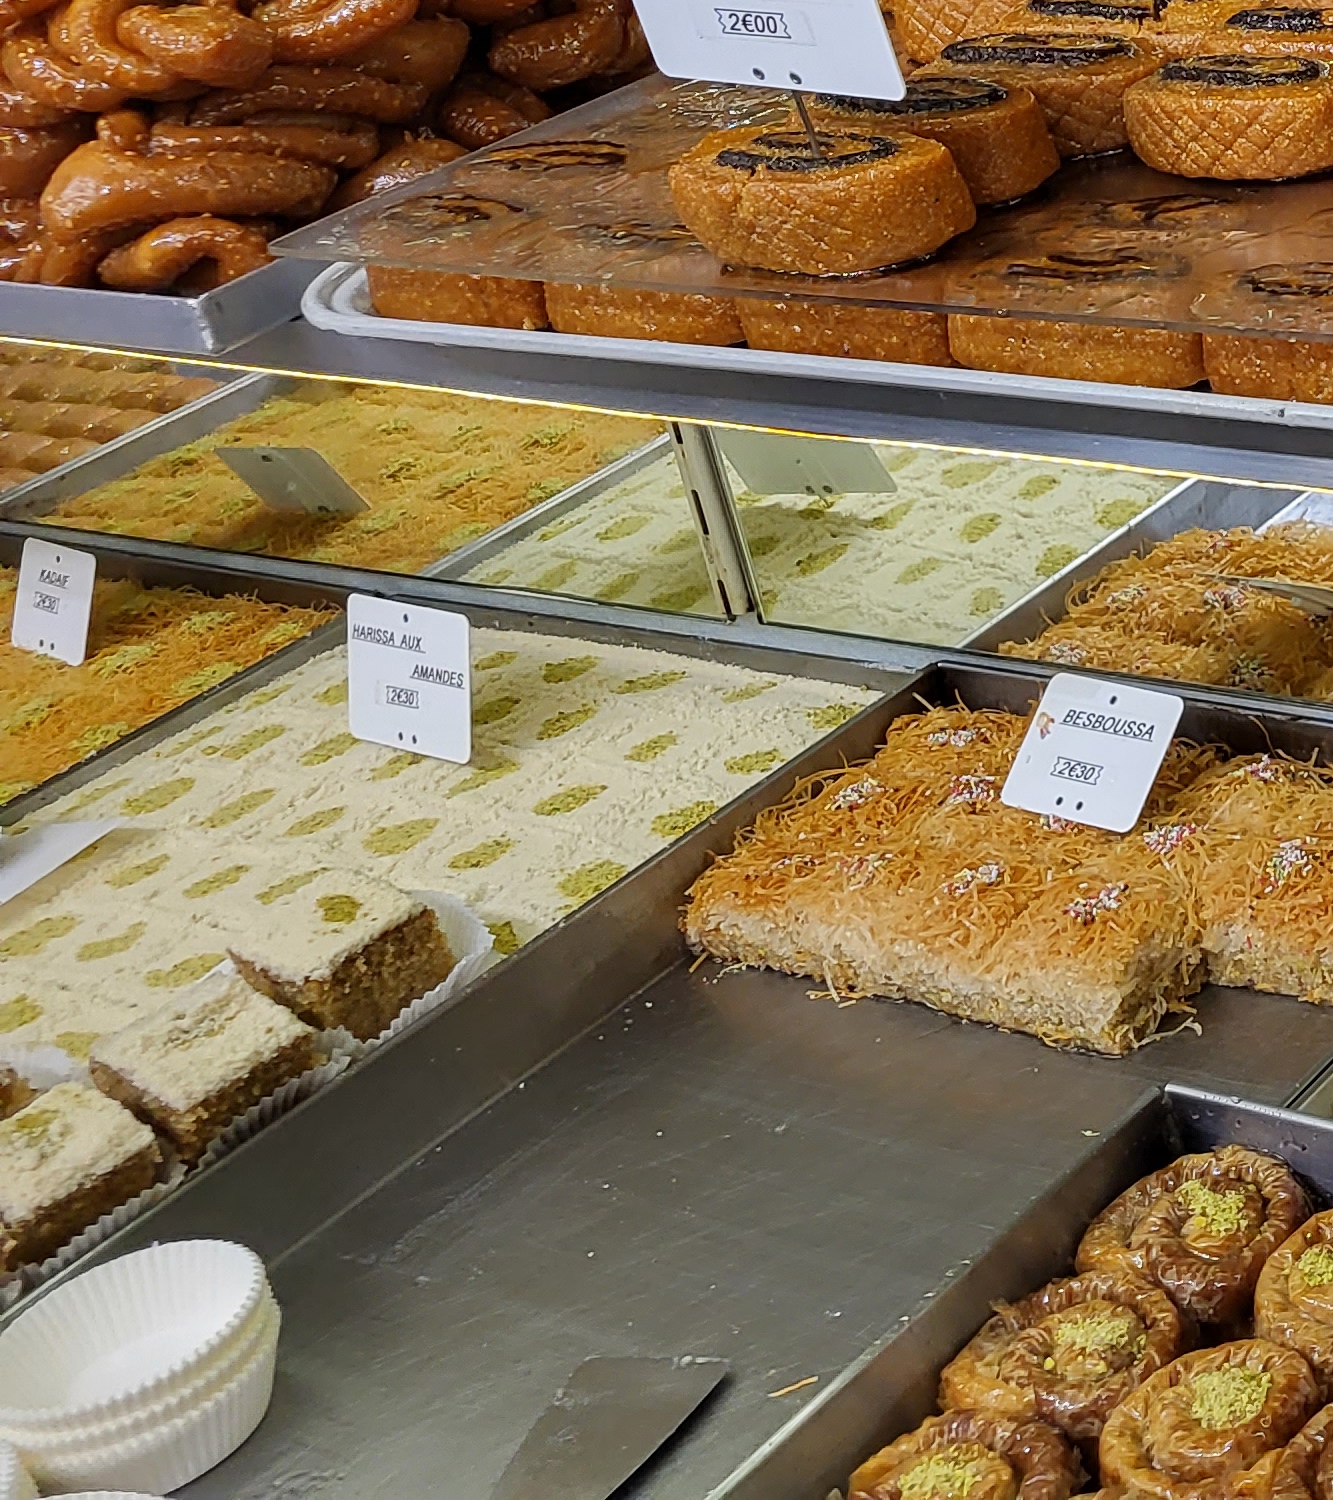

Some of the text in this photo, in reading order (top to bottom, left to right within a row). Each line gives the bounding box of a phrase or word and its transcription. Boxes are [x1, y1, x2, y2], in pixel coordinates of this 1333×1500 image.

[728, 12, 778, 34] 2€00
[352, 623, 422, 651] HARISSA AUX
[412, 664, 464, 688] AMANDES
[391, 689, 415, 705] 2€30
[1062, 709, 1155, 740] BESBOUSSA
[1057, 761, 1096, 781] 2€30
